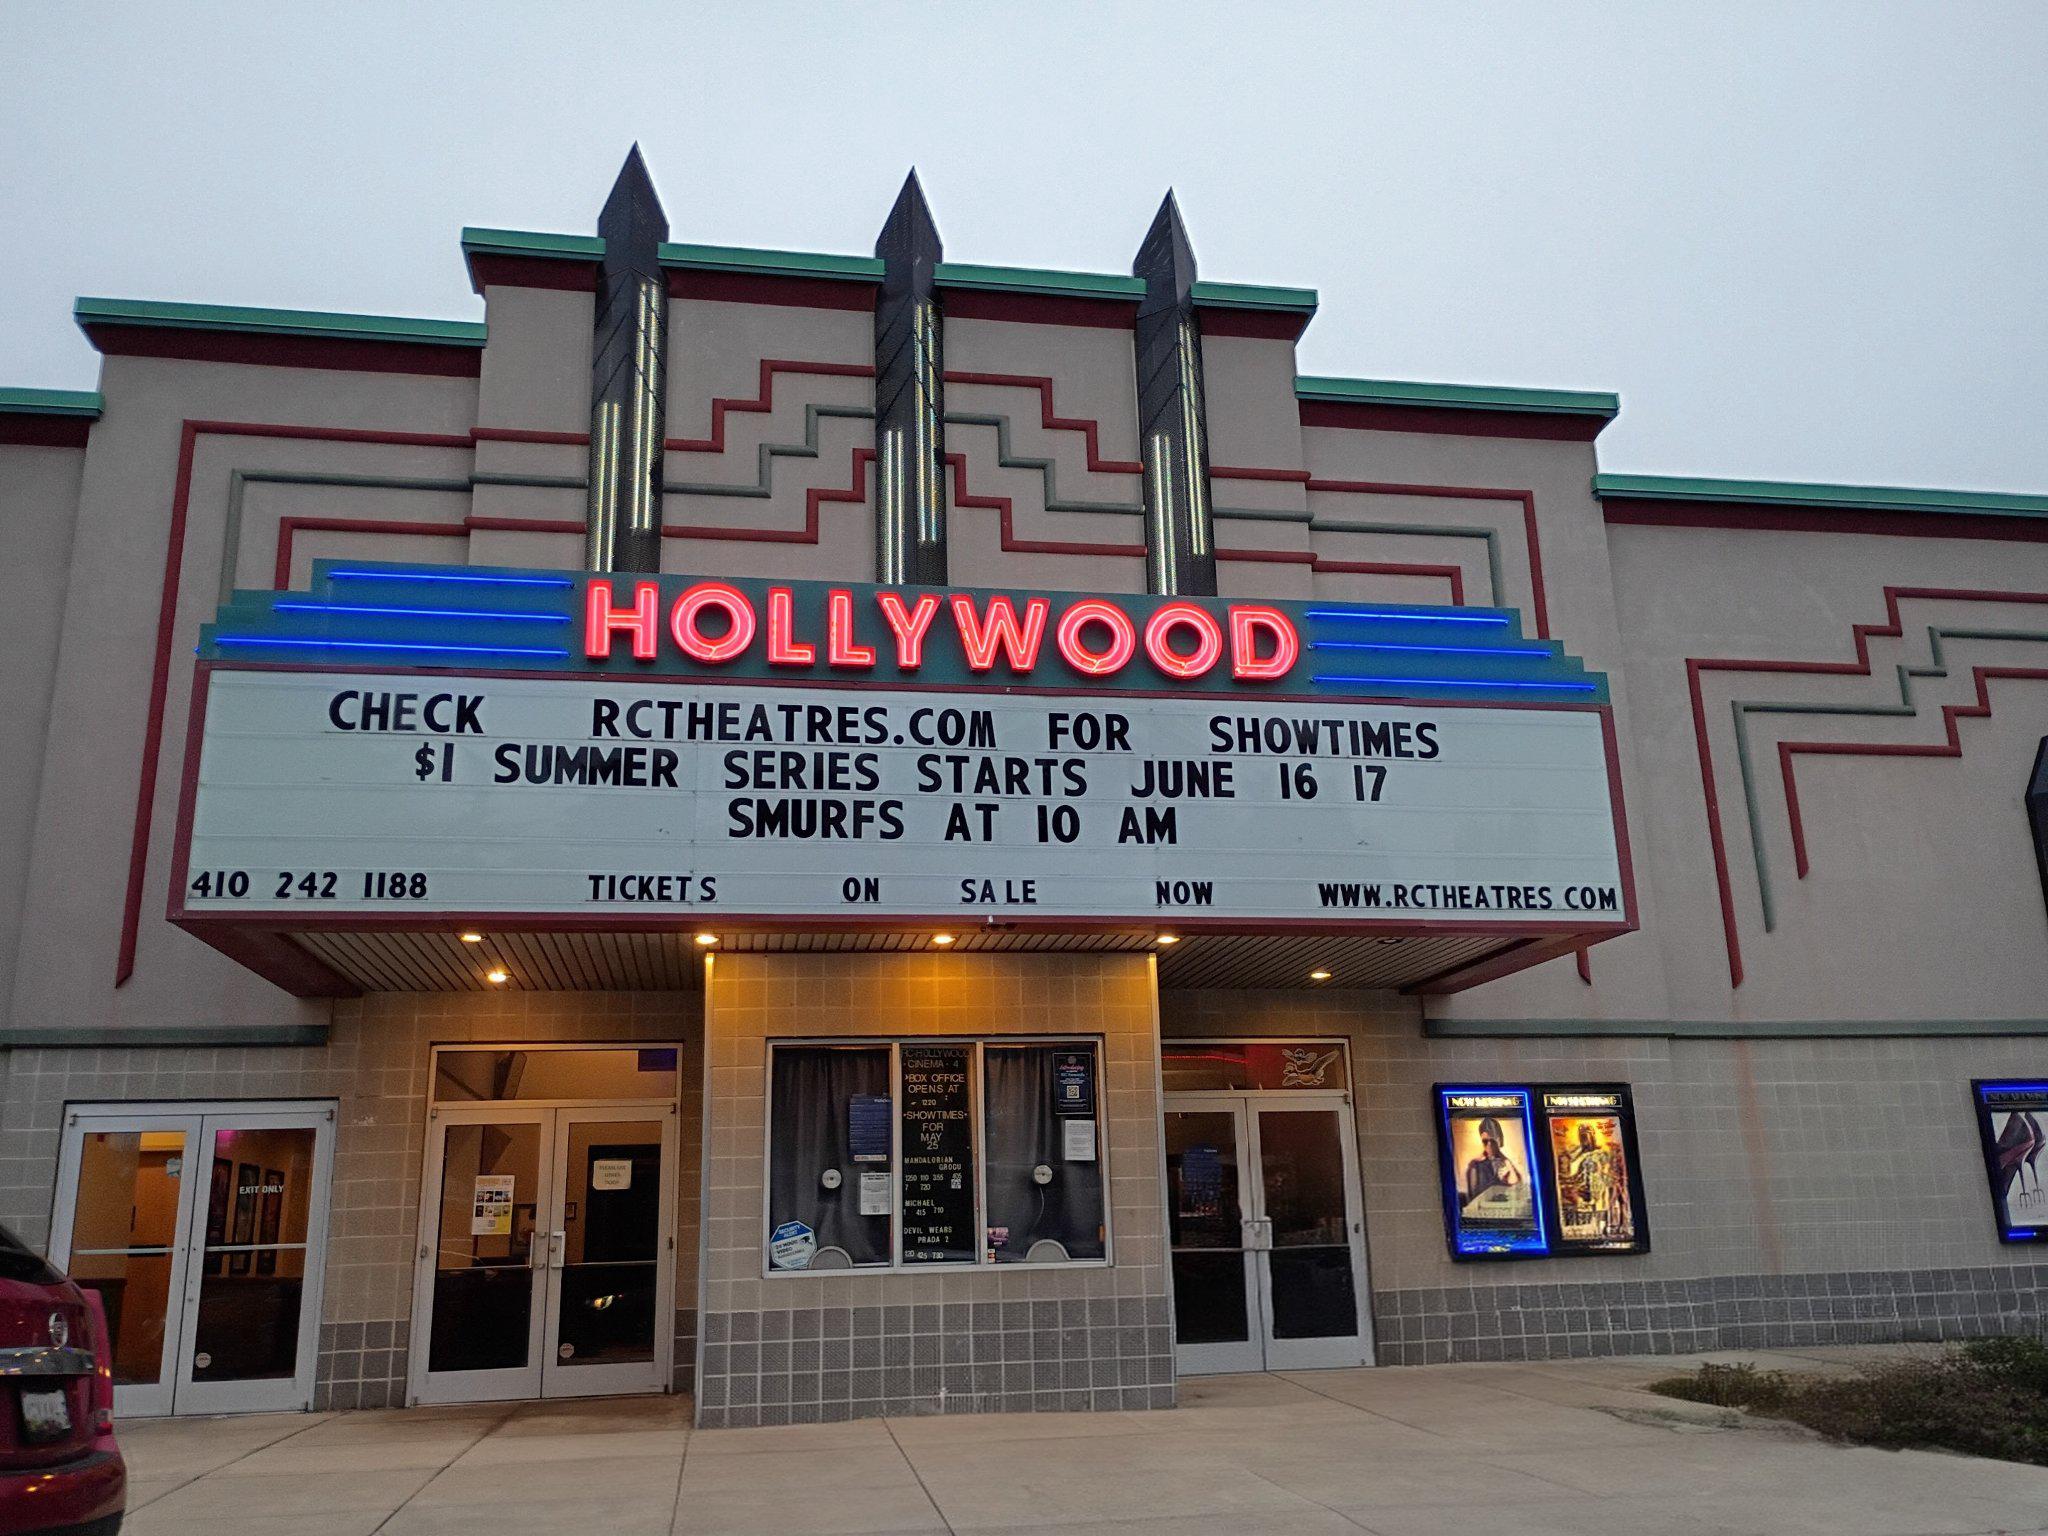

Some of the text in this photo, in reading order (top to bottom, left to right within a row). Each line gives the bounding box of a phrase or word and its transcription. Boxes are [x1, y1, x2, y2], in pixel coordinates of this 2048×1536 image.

[584, 578, 1299, 681] HOLLYWOOD
[328, 690, 1440, 760] CHECK RCTHEATRES.COM FOR SHOWTIMES
[414, 741, 1388, 802] $1 SUMMER SERIES STARTS JUNE 16 17
[728, 797, 1178, 845] SMURFS AT 10 AM
[190, 870, 427, 901] 410 242 1188
[588, 874, 1213, 907] TICKETS ON SALE NOW
[907, 1060, 944, 1068] CINEMA
[908, 1074, 965, 1082] BOX OFFICE
[908, 1084, 960, 1094] OPENS AT
[922, 1122, 944, 1132] FOR
[920, 1132, 942, 1142] MAY
[926, 1142, 939, 1150] 25
[240, 1185, 283, 1194] EXIT ONLY
[904, 1226, 953, 1234] DEVIL WEARS
[918, 1236, 940, 1244] PRADA
